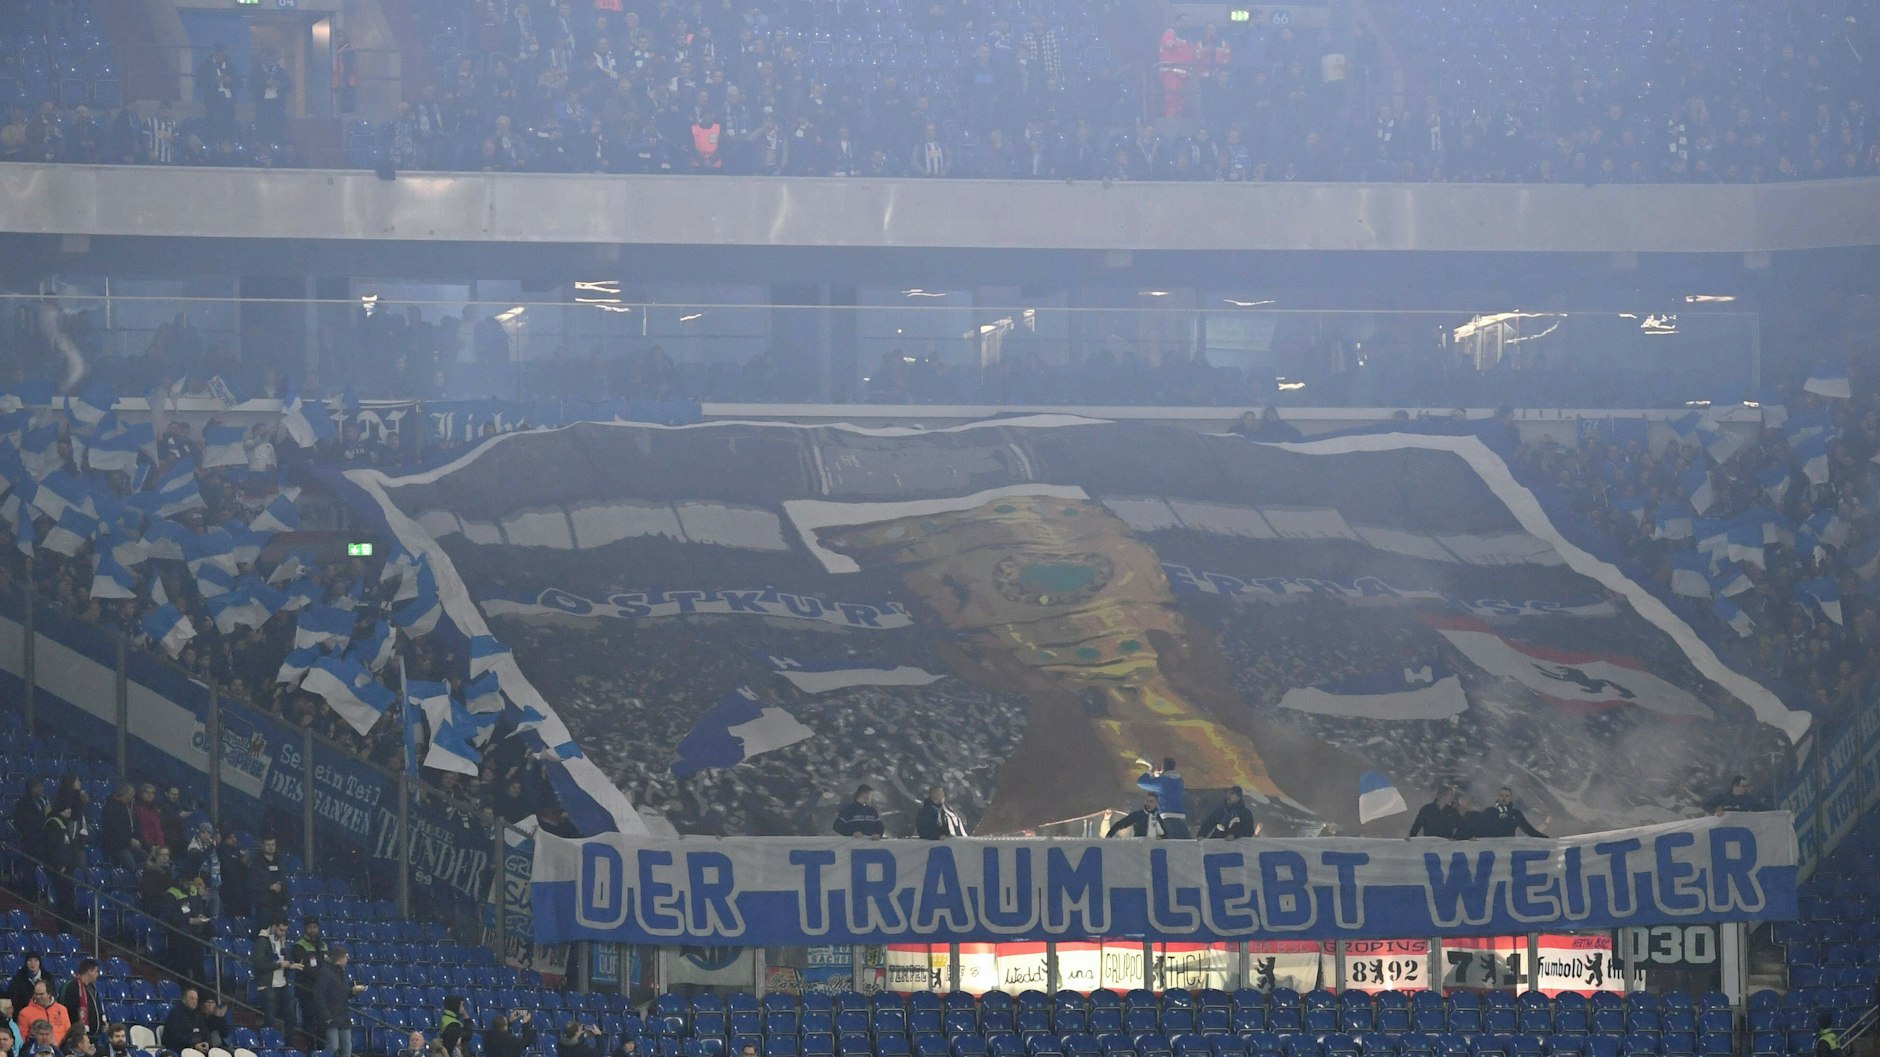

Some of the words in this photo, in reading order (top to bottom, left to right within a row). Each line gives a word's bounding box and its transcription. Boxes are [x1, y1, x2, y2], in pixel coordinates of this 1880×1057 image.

[1272, 13, 1288, 24] 66
[280, 743, 305, 771] Se
[315, 764, 342, 790] ein
[347, 775, 381, 805] Teil
[575, 840, 745, 938] DER
[789, 846, 1111, 938] TRAUM
[1145, 848, 1369, 936] LEBT
[1423, 826, 1767, 927] WEITER
[1618, 925, 1717, 963] 030
[1105, 953, 1143, 983] GRUPPO
[1447, 951, 1473, 982] 7
